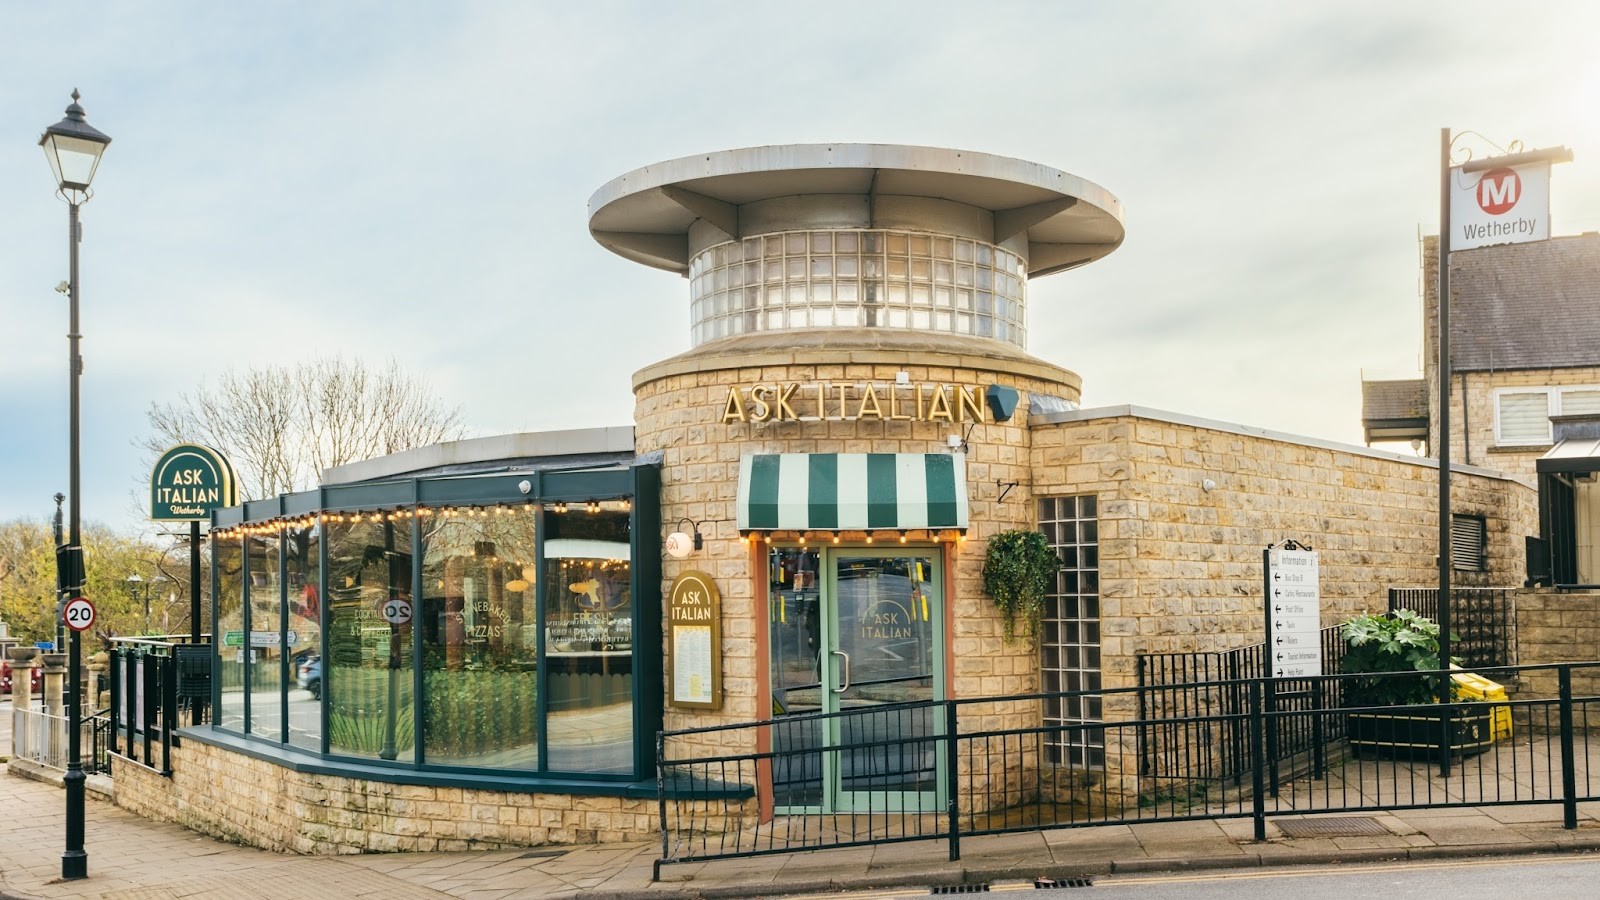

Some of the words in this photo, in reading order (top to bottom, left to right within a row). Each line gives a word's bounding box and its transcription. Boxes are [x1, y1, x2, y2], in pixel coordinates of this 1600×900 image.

[1482, 174, 1516, 207] M
[1463, 217, 1537, 240] Wetherby
[722, 383, 800, 424] ASK
[817, 381, 987, 424] ITALIAN
[173, 469, 203, 485] ASK
[157, 487, 219, 503] ITALIAN
[170, 505, 206, 516] Wetherby
[681, 591, 701, 605] ASK
[69, 607, 91, 621] 20
[354, 609, 387, 620] COCKTAIL
[455, 601, 511, 625] STNEBAKED
[671, 607, 711, 620] ITALIAN
[874, 612, 899, 625] ASK
[465, 625, 501, 638] PIZZAS
[862, 626, 911, 639] ITALIAN
